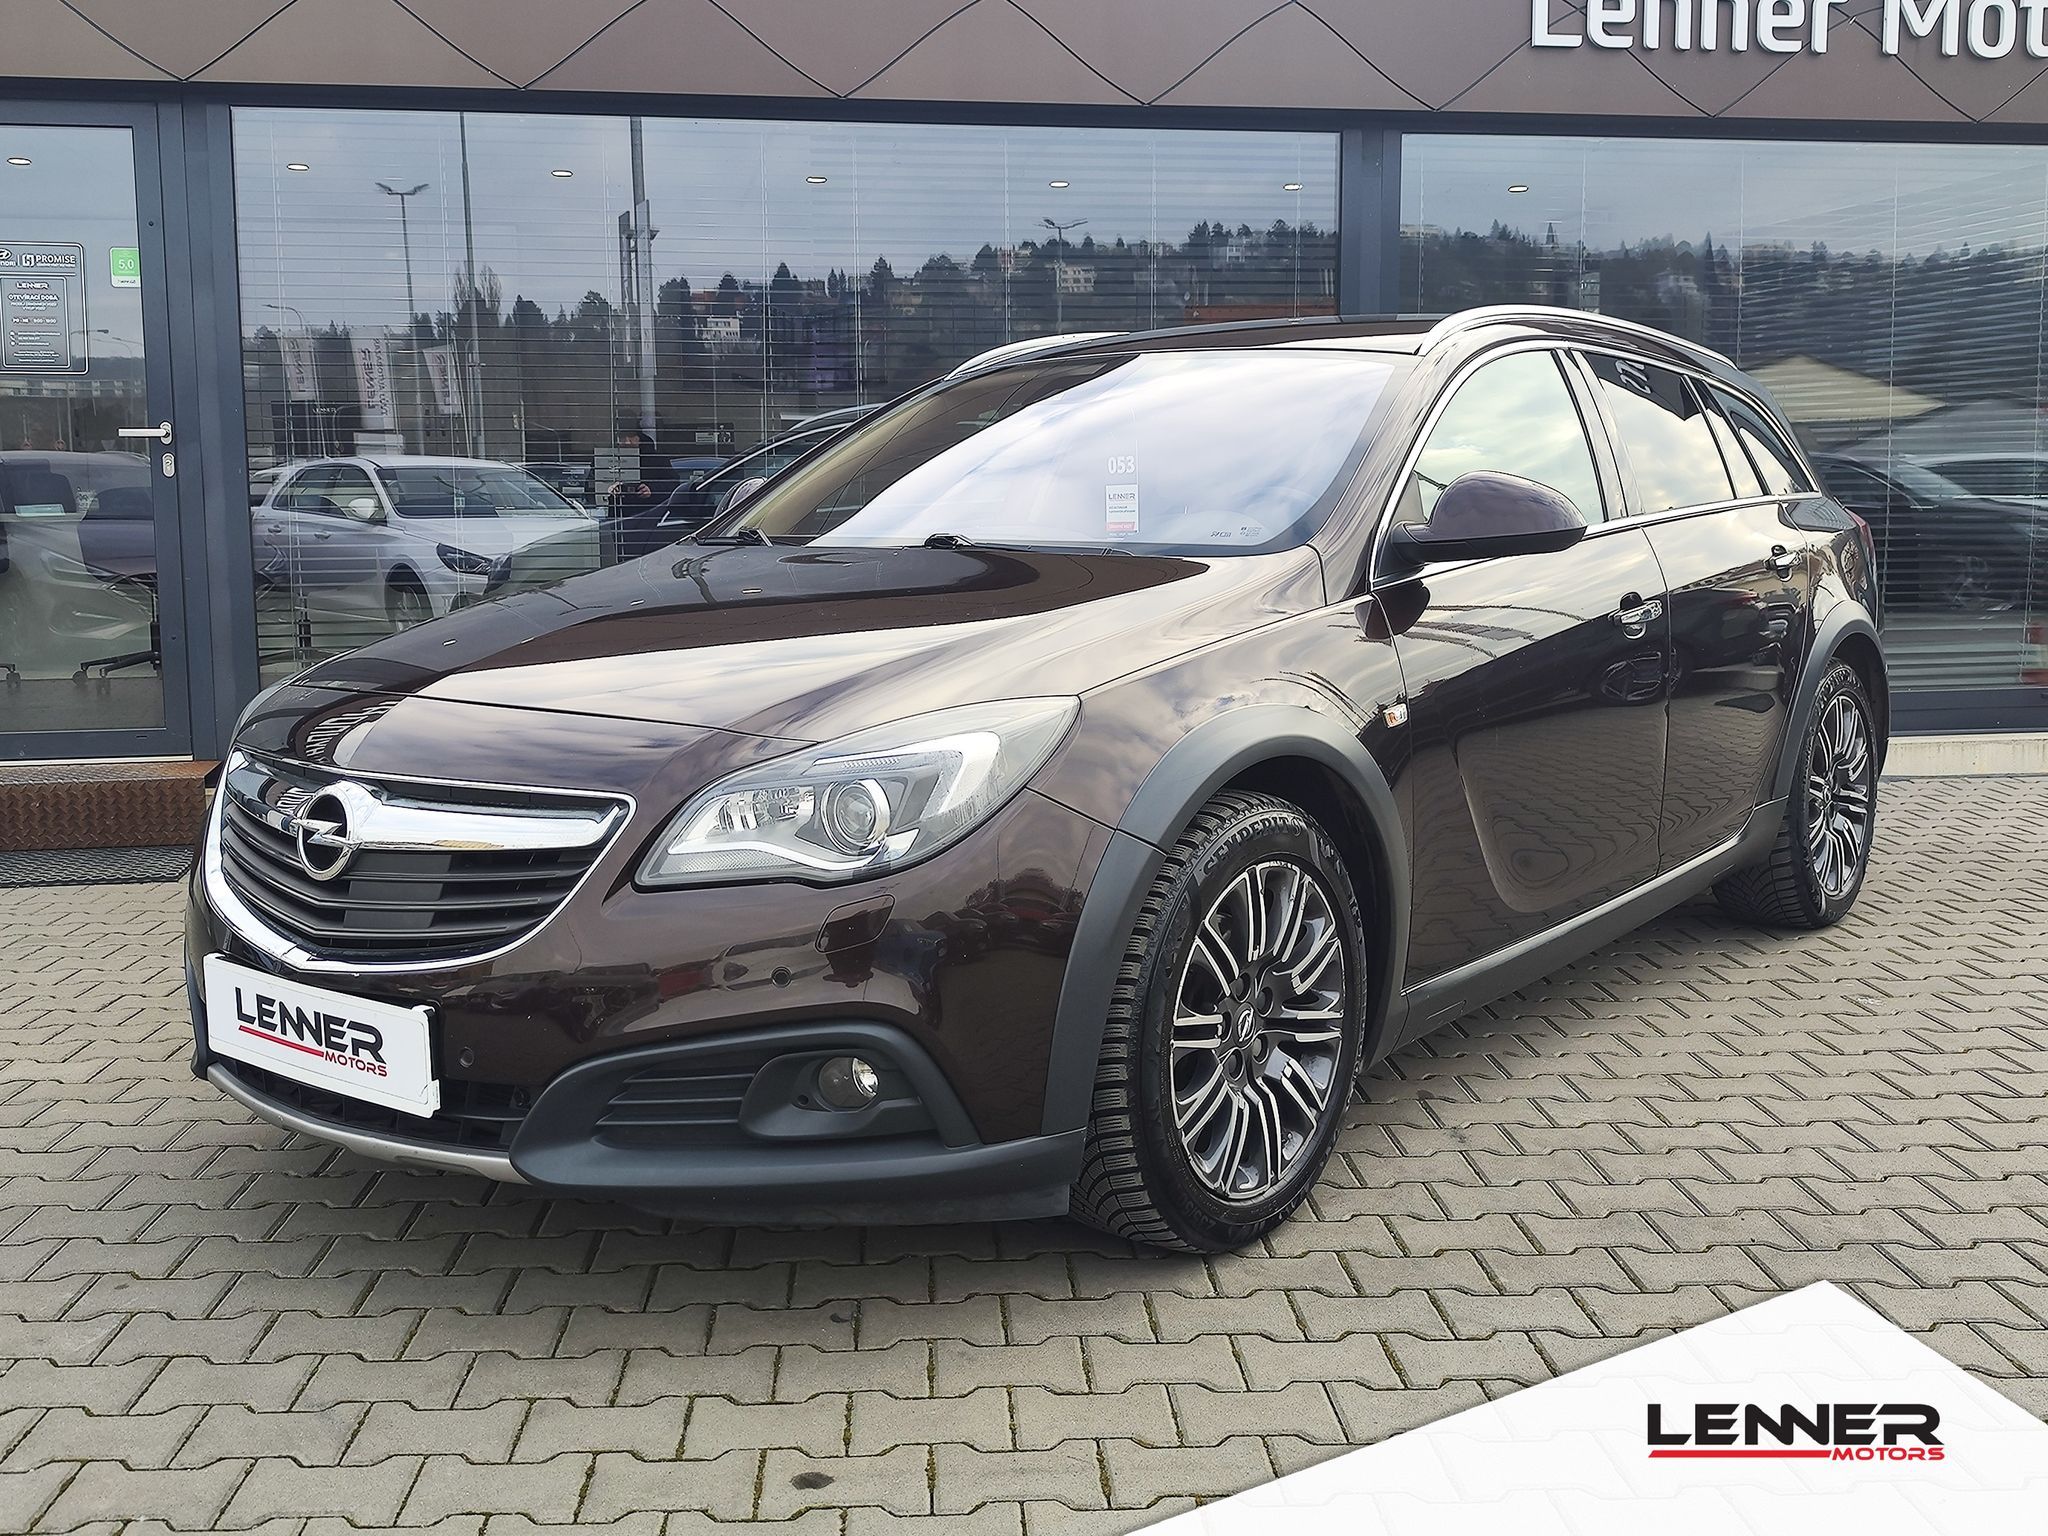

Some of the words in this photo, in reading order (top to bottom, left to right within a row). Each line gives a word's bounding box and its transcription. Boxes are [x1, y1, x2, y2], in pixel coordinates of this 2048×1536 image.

[1531, 0, 1849, 54] Lenner
[36, 254, 76, 264] PROMISE
[1107, 456, 1136, 474] 053
[235, 986, 387, 1064] LENNER
[324, 1050, 388, 1077] MOTORS
